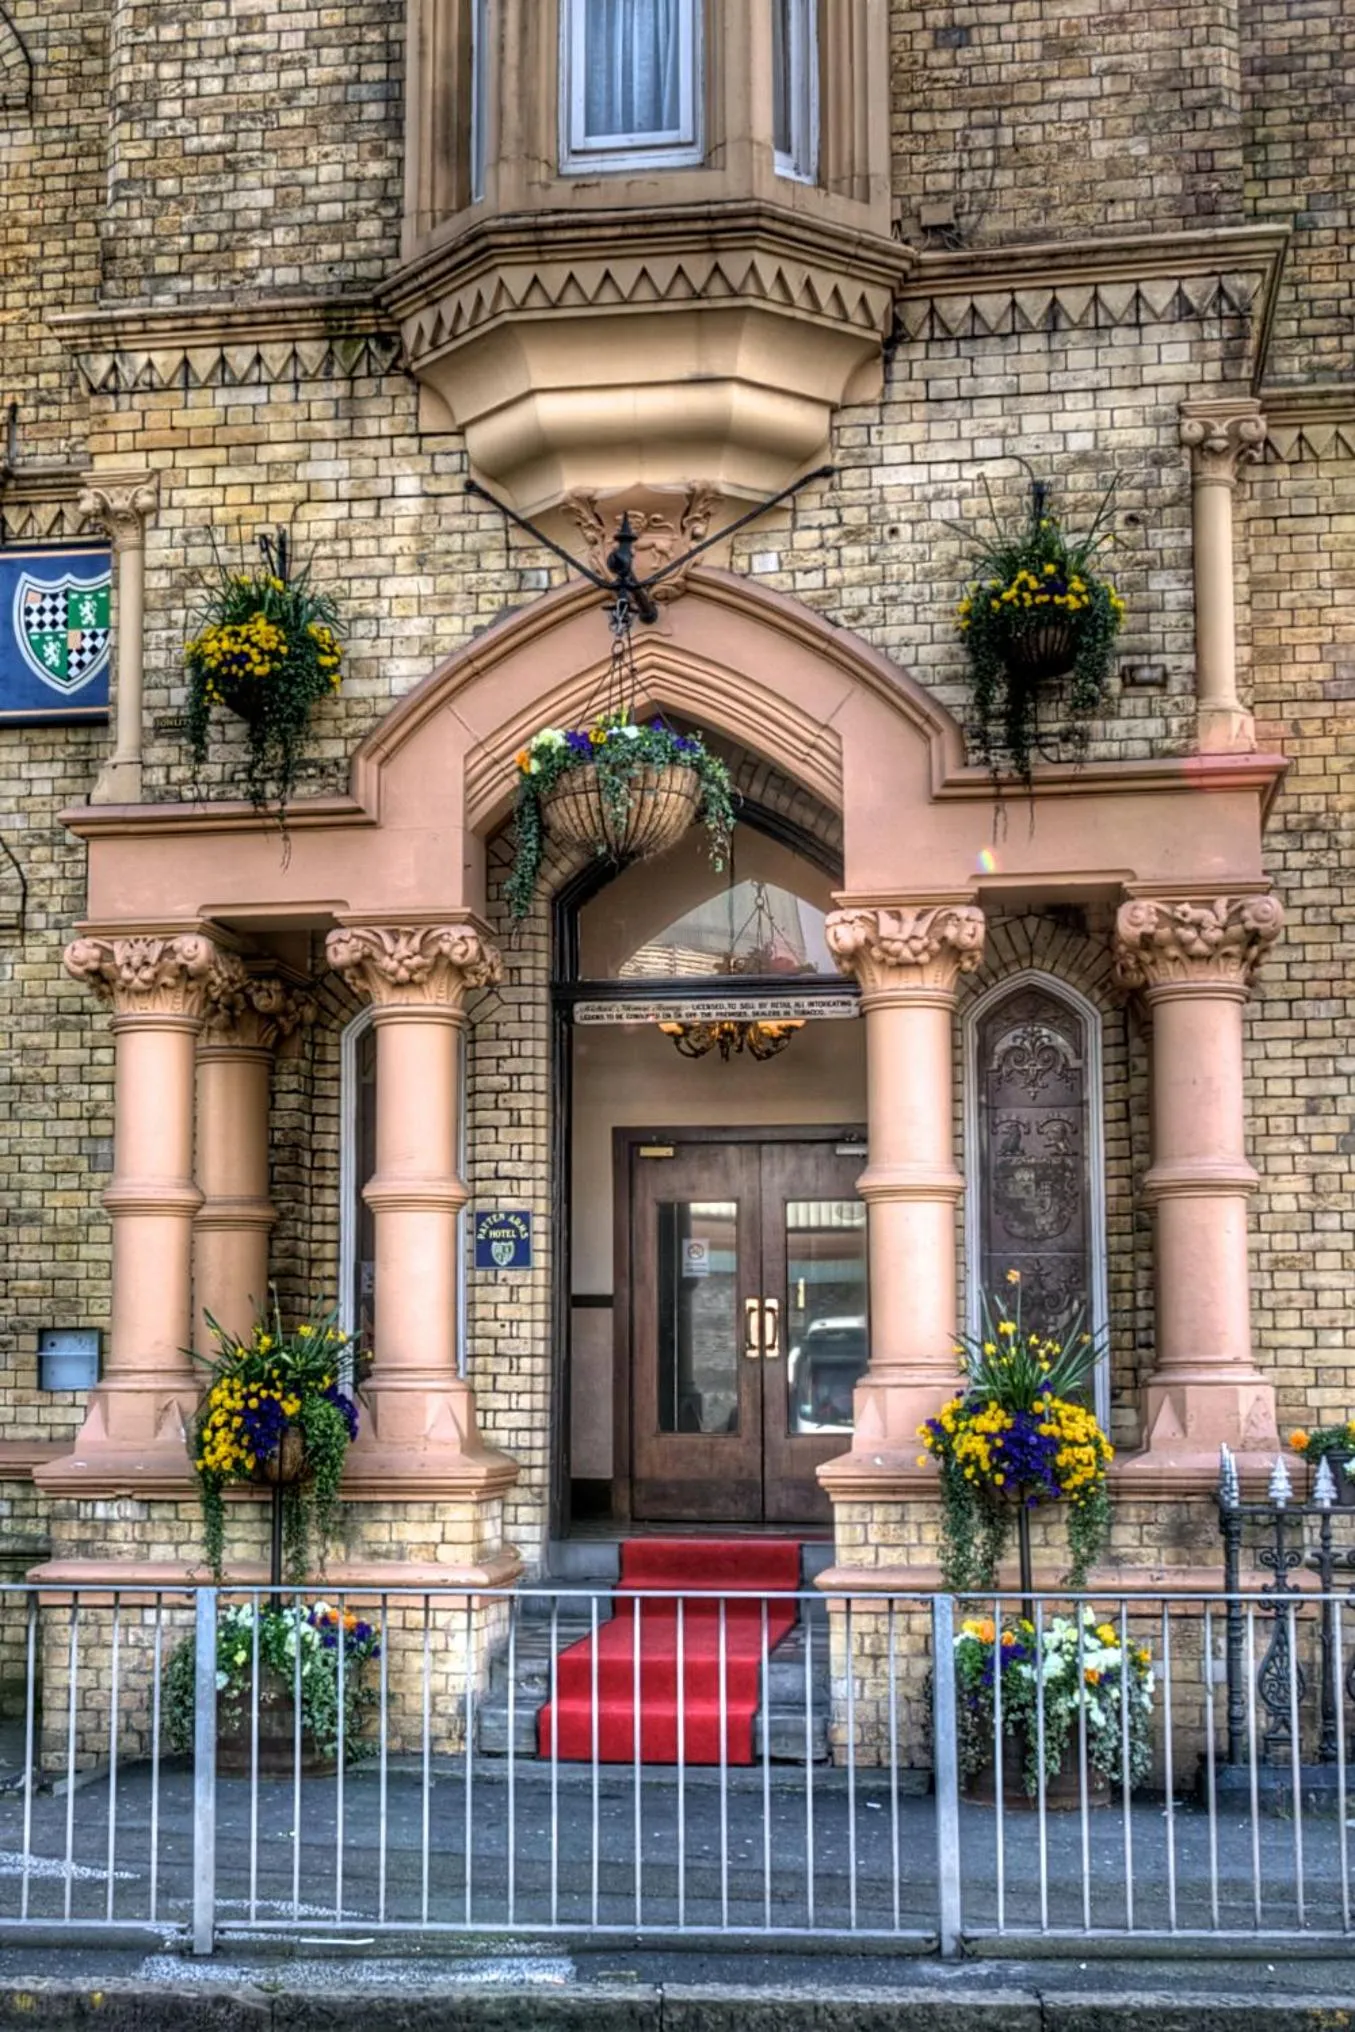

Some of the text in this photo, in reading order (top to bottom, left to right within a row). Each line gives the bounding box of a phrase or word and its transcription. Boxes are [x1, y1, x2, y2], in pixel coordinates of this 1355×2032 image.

[807, 1000, 852, 1008] INTOXICATING
[477, 1213, 528, 1239] PATTEN ARMS
[488, 1229, 516, 1239] HOTEL
